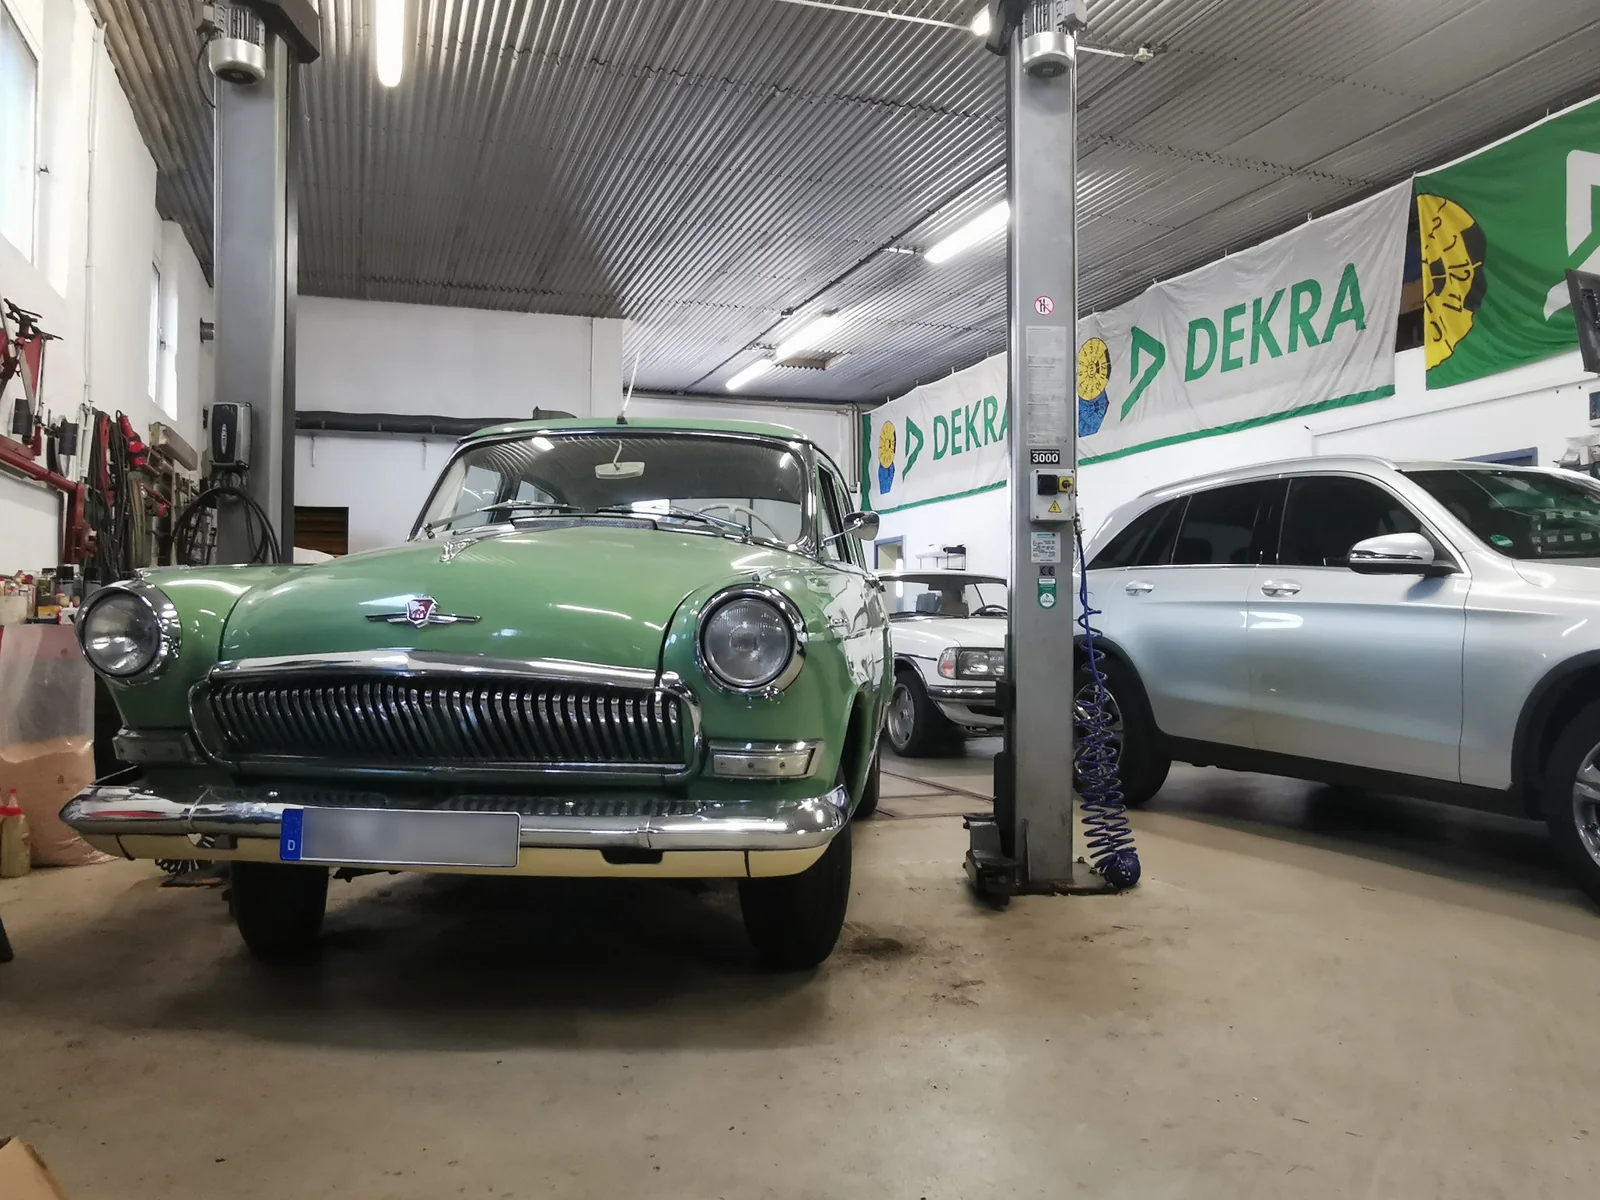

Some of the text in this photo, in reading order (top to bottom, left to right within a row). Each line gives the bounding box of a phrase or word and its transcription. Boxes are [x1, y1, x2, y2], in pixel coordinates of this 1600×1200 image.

[1448, 259, 1471, 285] 12
[1184, 263, 1367, 382] DEKRA
[1032, 453, 1059, 463] 3000
[287, 839, 296, 851] D
